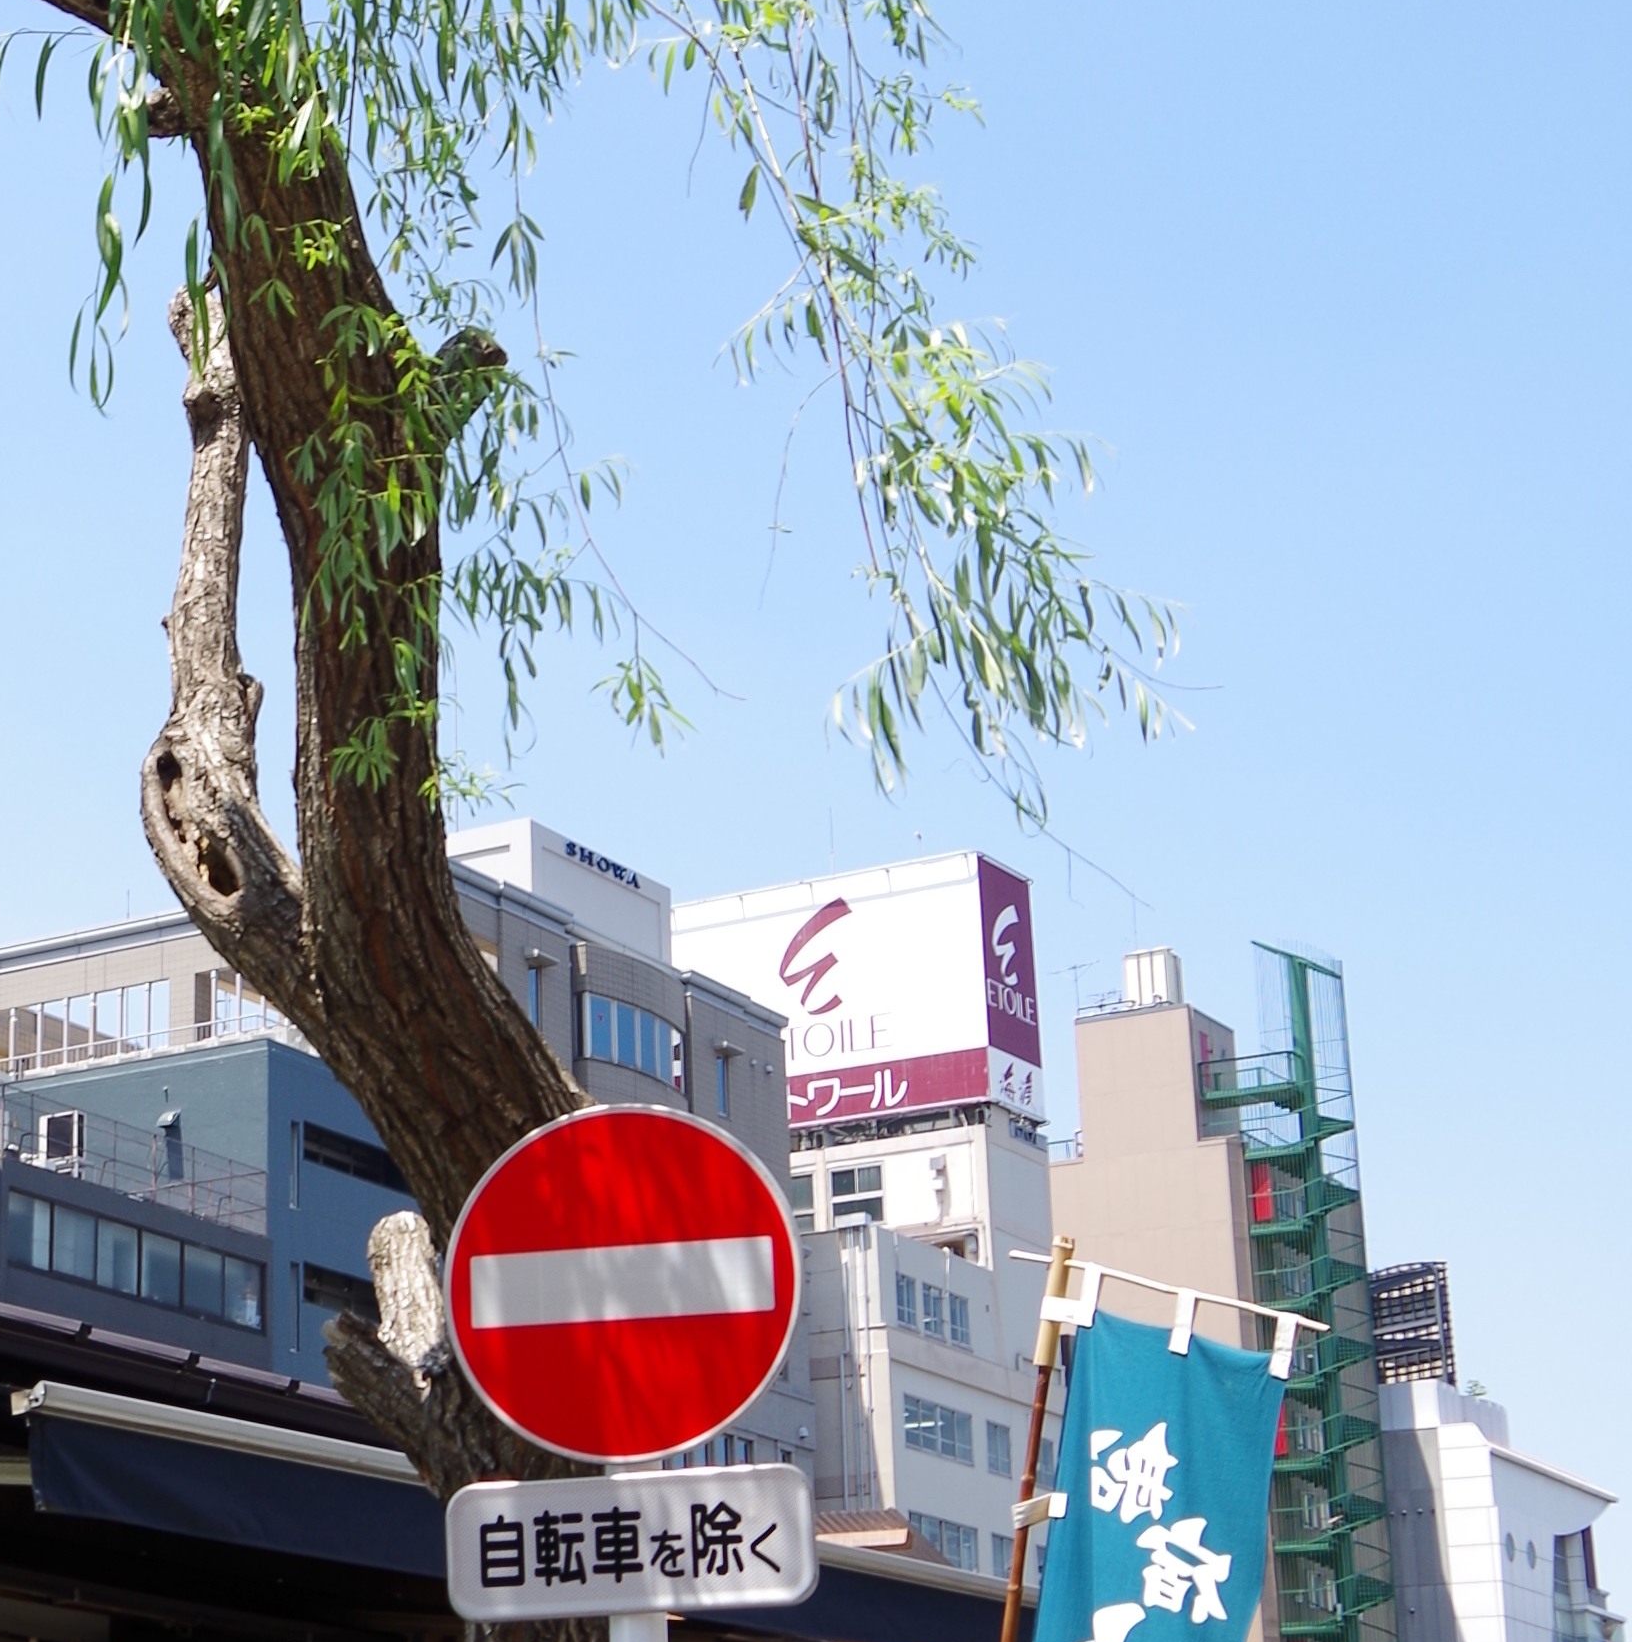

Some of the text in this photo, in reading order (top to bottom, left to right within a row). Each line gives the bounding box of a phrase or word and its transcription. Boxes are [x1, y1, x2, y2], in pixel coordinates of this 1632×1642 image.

[565, 840, 641, 889] SHOWA
[986, 977, 1037, 1026] ETOILE
[480, 1500, 781, 1588] 自転車を除く
